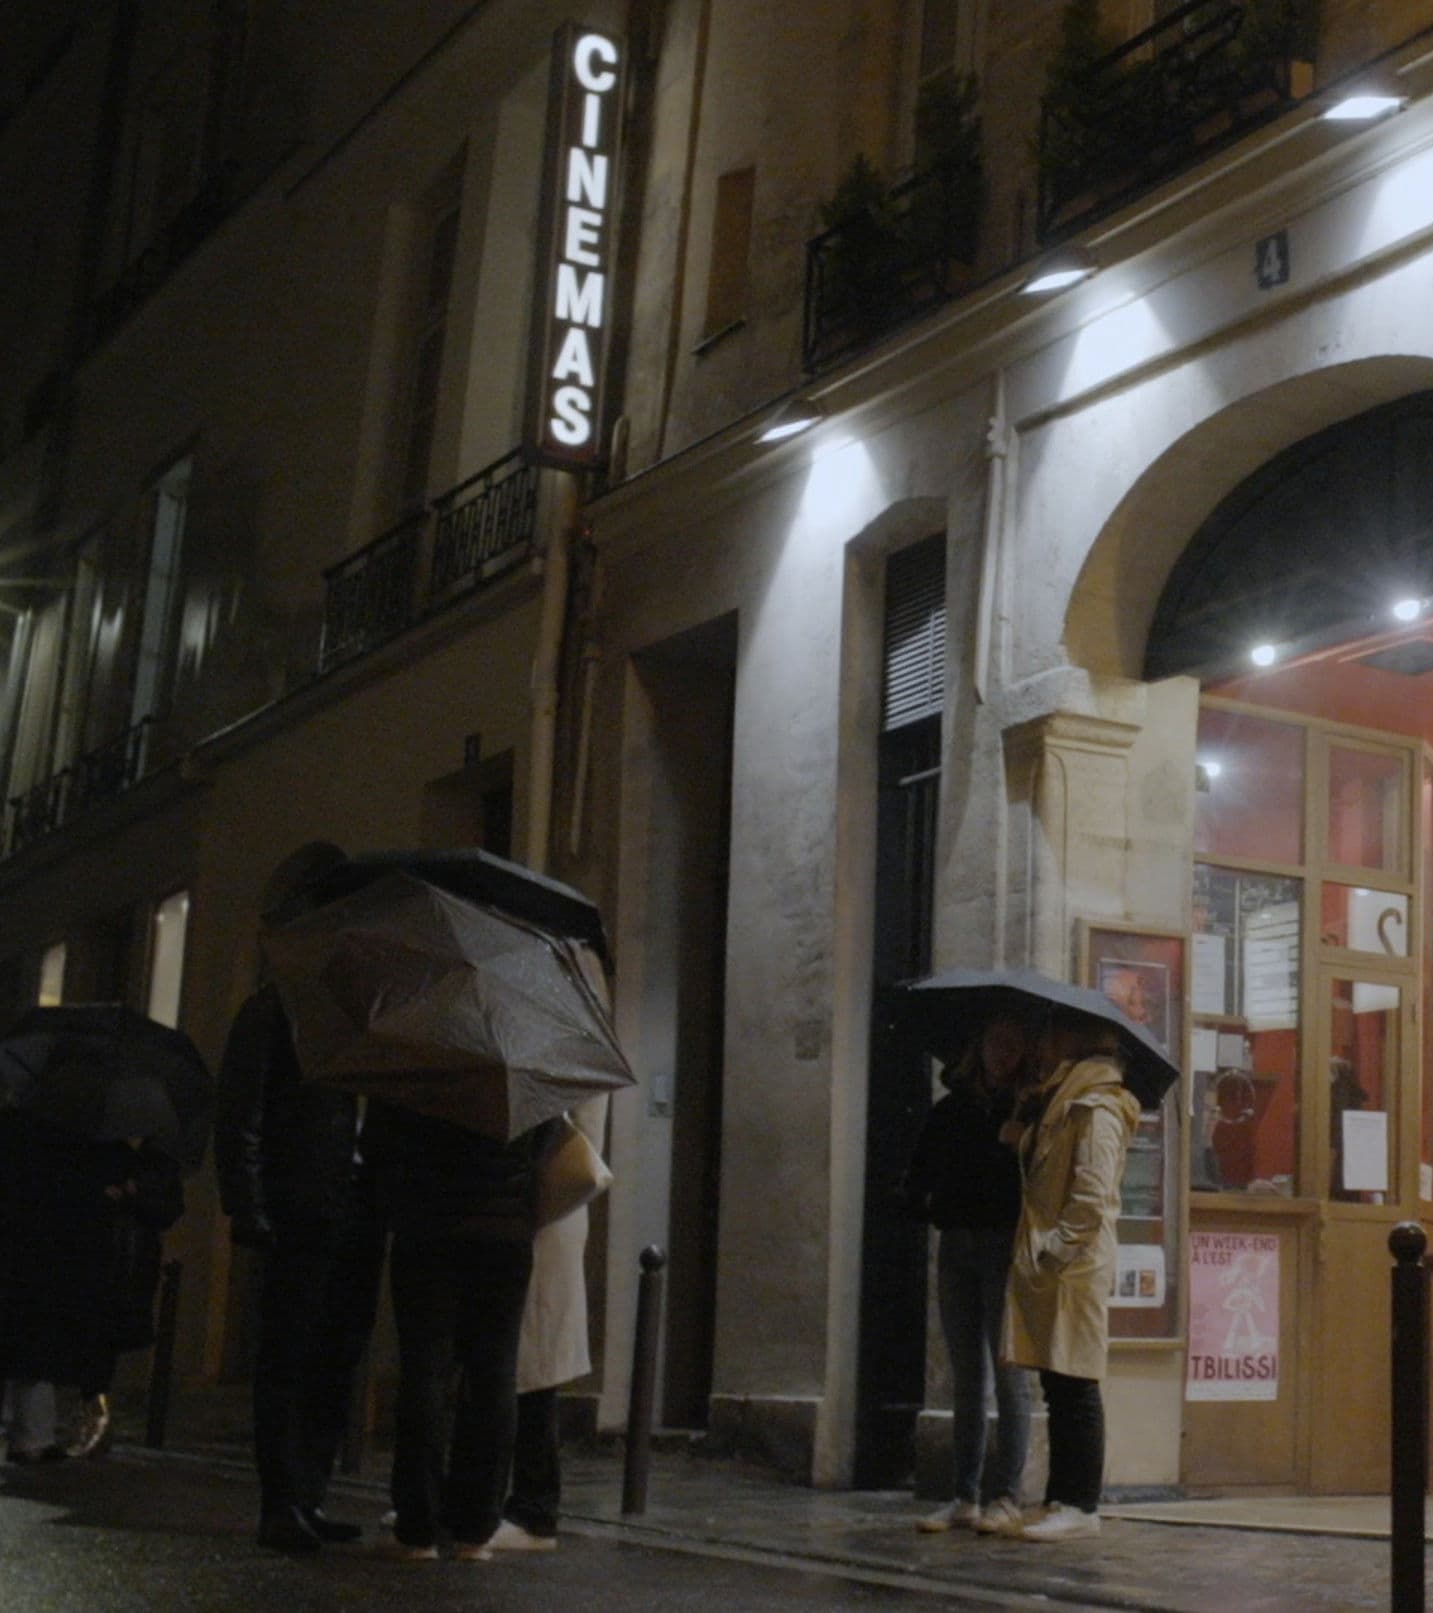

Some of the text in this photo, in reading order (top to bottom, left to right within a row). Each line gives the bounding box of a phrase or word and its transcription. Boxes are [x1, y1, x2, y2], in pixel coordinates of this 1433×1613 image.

[551, 34, 618, 446] CINEMAS
[1263, 239, 1281, 281] 4
[1191, 1235, 1277, 1252] UN WEEK-END
[1191, 1355, 1276, 1379] TBILISSI
